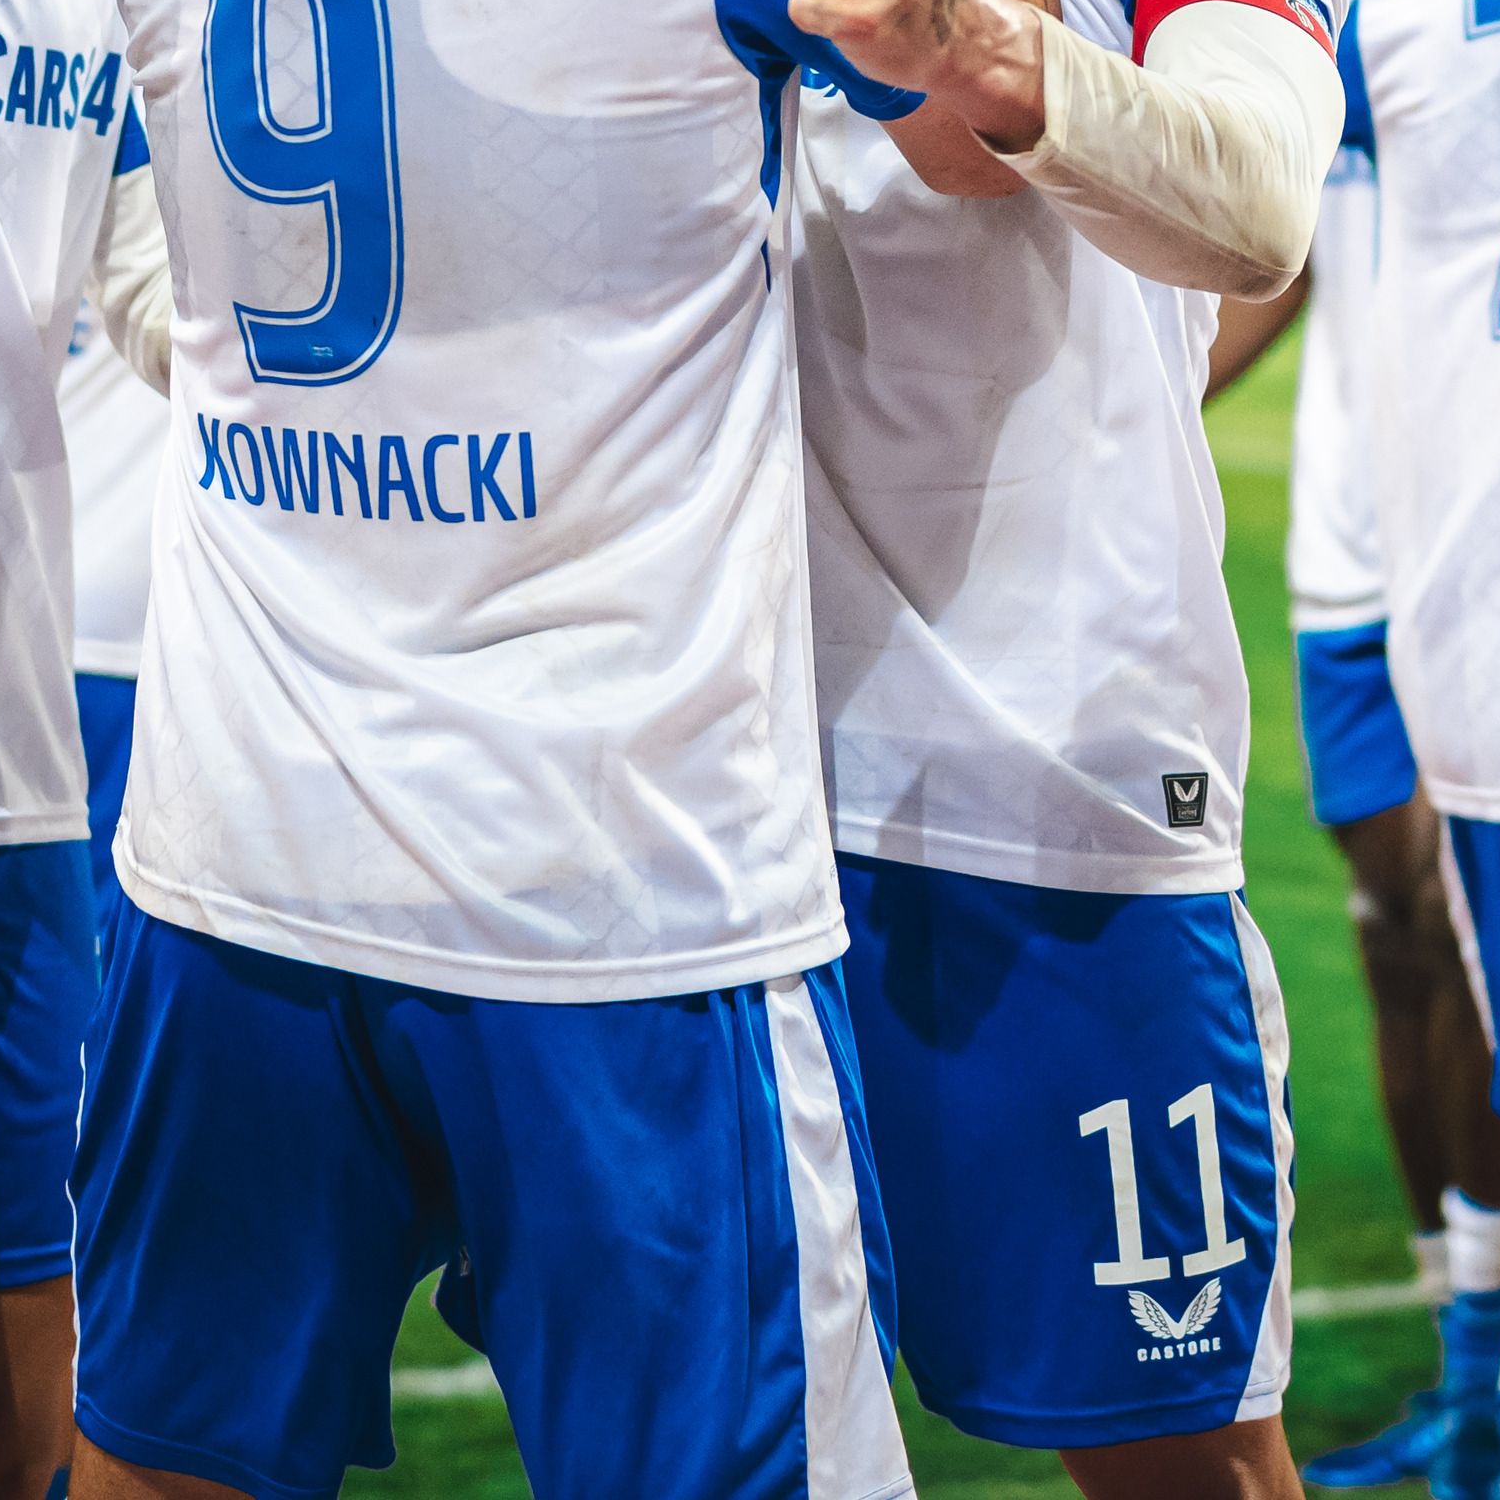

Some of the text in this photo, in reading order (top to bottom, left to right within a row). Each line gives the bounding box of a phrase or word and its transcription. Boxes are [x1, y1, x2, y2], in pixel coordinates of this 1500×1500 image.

[197, 412, 537, 524] KOWNACKI
[1078, 1083, 1247, 1286] 11
[1137, 1337, 1221, 1362] CASTORE
